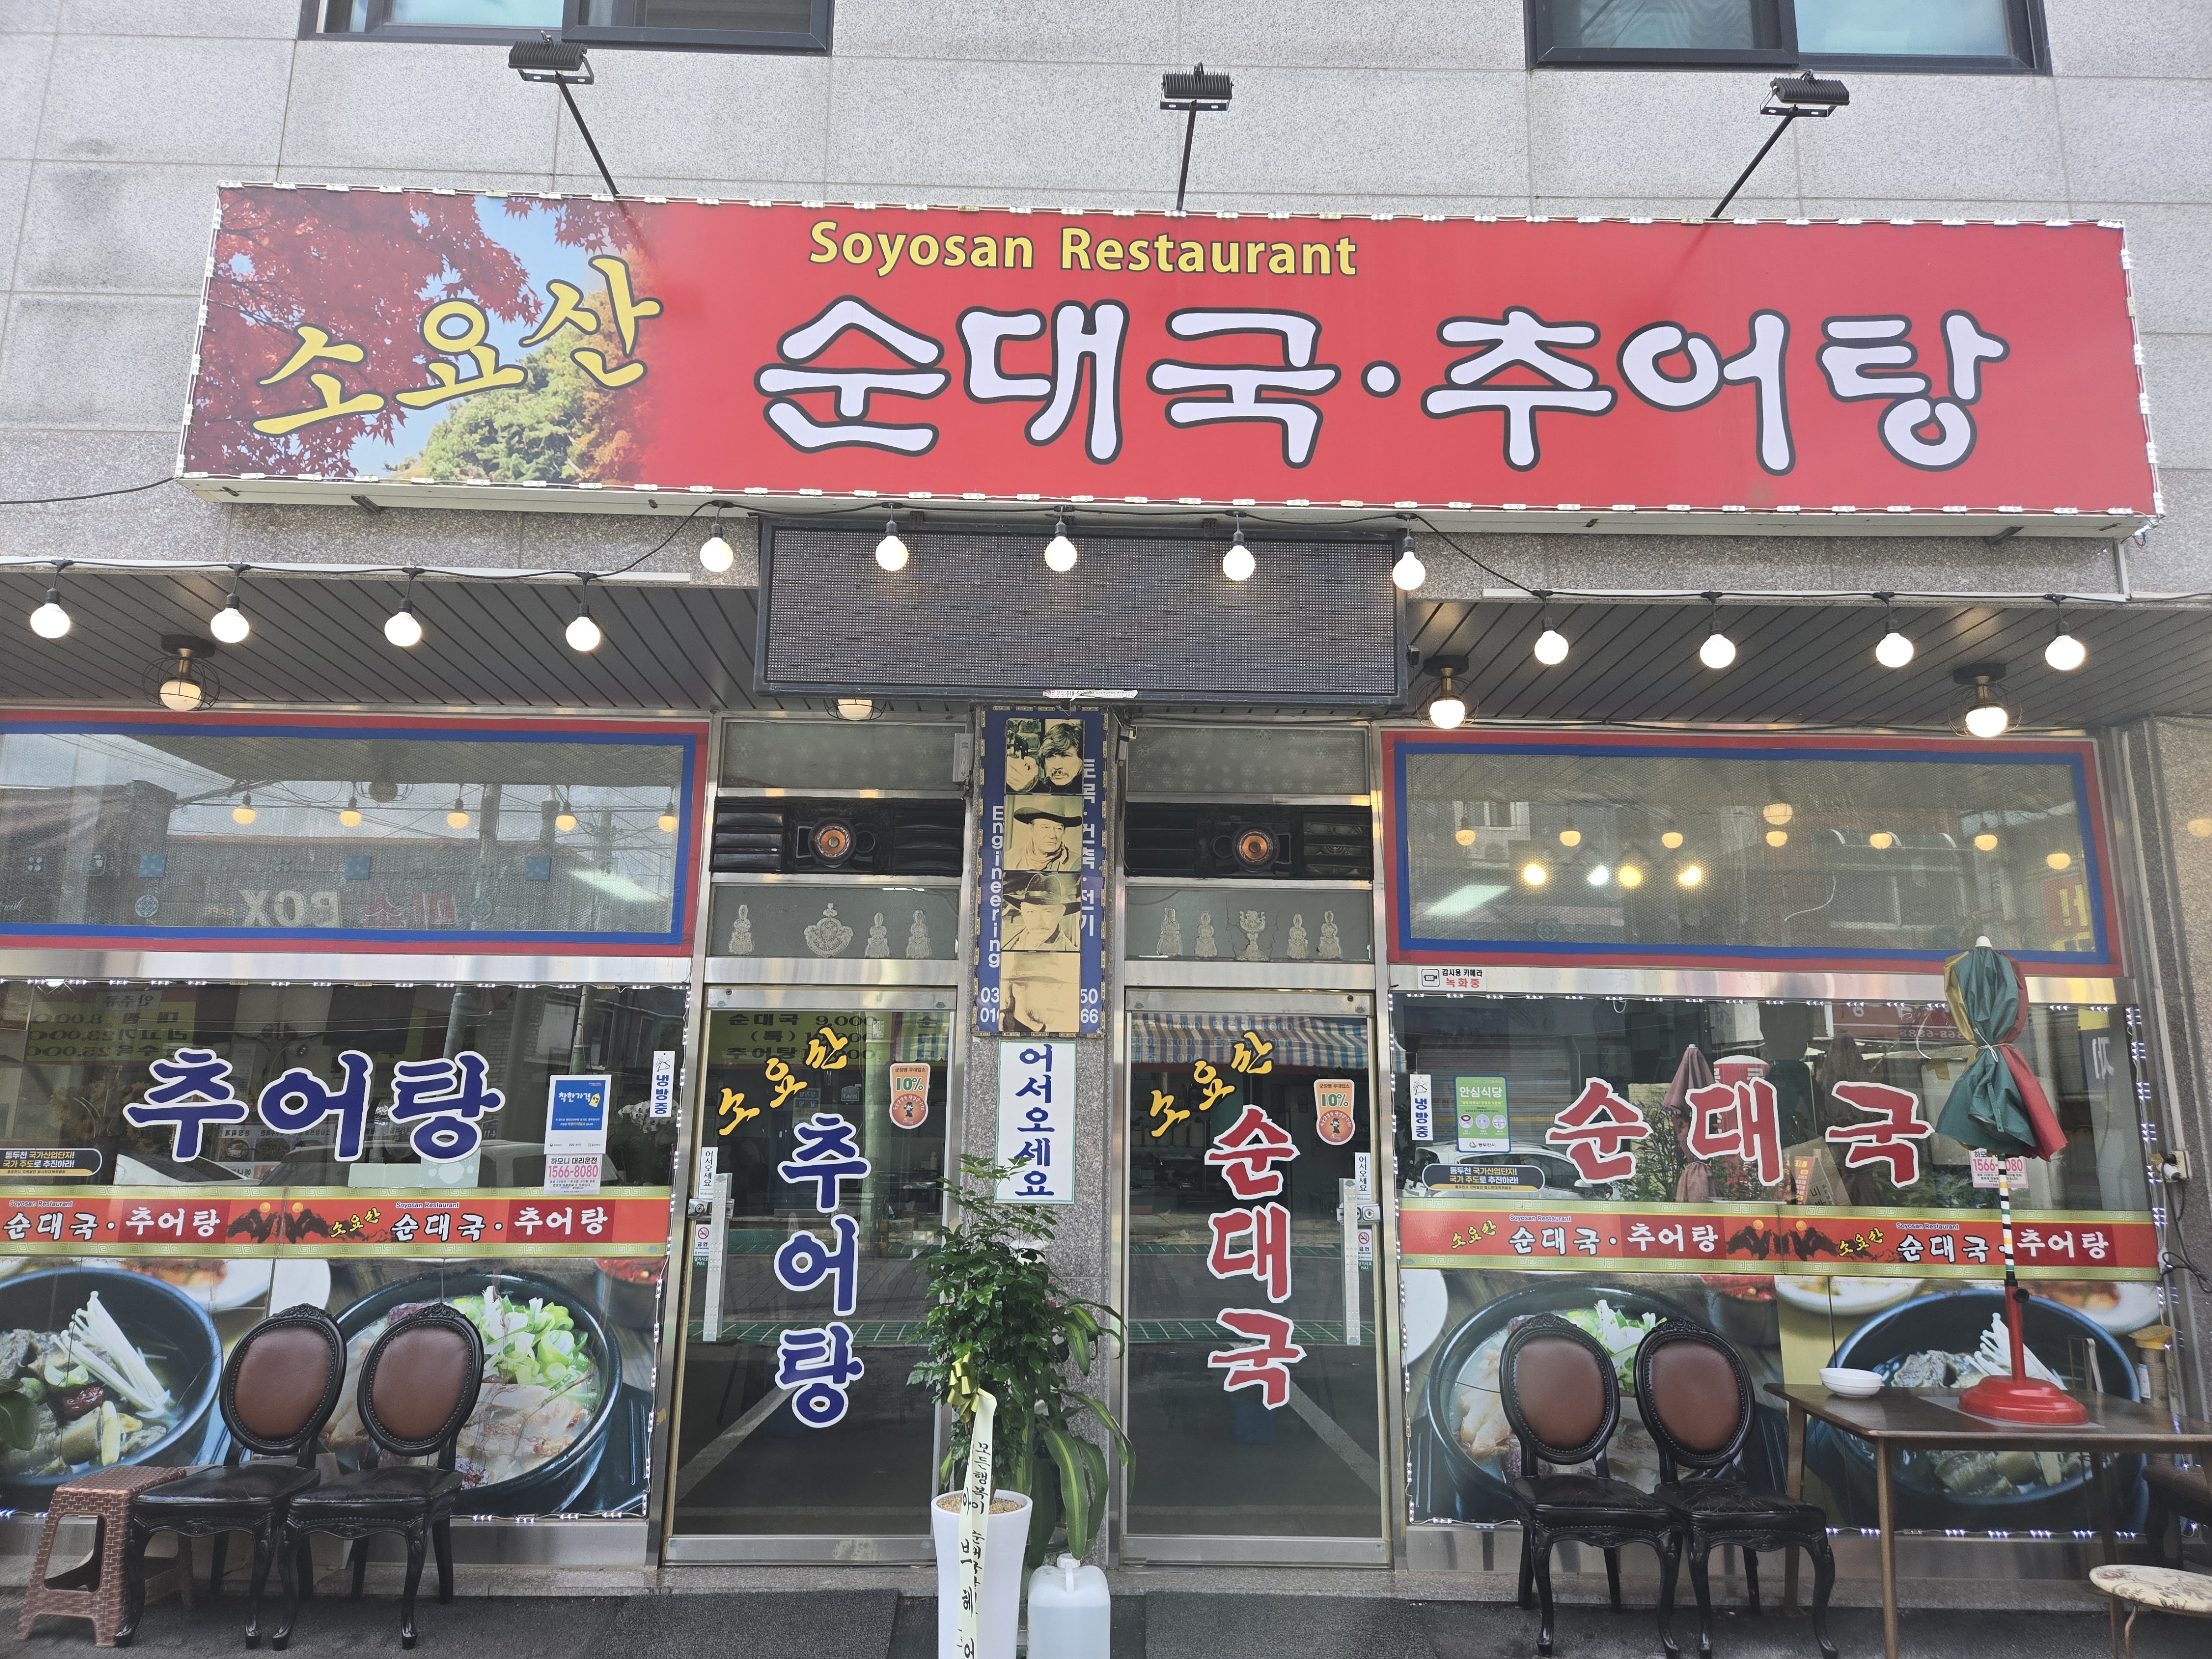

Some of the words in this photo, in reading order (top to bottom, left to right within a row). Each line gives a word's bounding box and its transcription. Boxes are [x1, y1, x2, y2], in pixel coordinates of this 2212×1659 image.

[809, 220, 1035, 276] Soyosan
[1060, 226, 1358, 276] Restaurant
[251, 254, 664, 437] 소요산
[988, 806, 1004, 968] Engineering
[1446, 978, 1480, 988] 녹화중
[728, 1013, 799, 1026] 순대국
[559, 1092, 591, 1102] 착한가격
[655, 1074, 669, 1115] 냉방중
[896, 1077, 924, 1091] 10%
[1321, 1093, 1349, 1107] 10%
[1459, 1087, 1503, 1098] 안심식당
[123, 1048, 505, 1162] 추어탕
[1014, 1044, 1055, 1196] 어서오세요
[1414, 1097, 1428, 1138] 냉방중
[1546, 1077, 1935, 1188] 순대국
[549, 1165, 598, 1178] 1566-8080
[703, 1151, 713, 1186] 어서오세요
[1359, 1156, 1368, 1191] 어서오세요
[1473, 1167, 1517, 1176] 국가산업단지!
[1973, 1159, 2023, 1171] 1566-080
[395, 1201, 423, 1209] Soyosan
[424, 1201, 460, 1209] Restaurant
[330, 1207, 380, 1239] 소요산
[1451, 1219, 1497, 1249] 소요산
[1204, 1104, 1307, 1410] 순대국
[1838, 1228, 1884, 1257] 소요산
[774, 1113, 872, 1428] 추어탕
